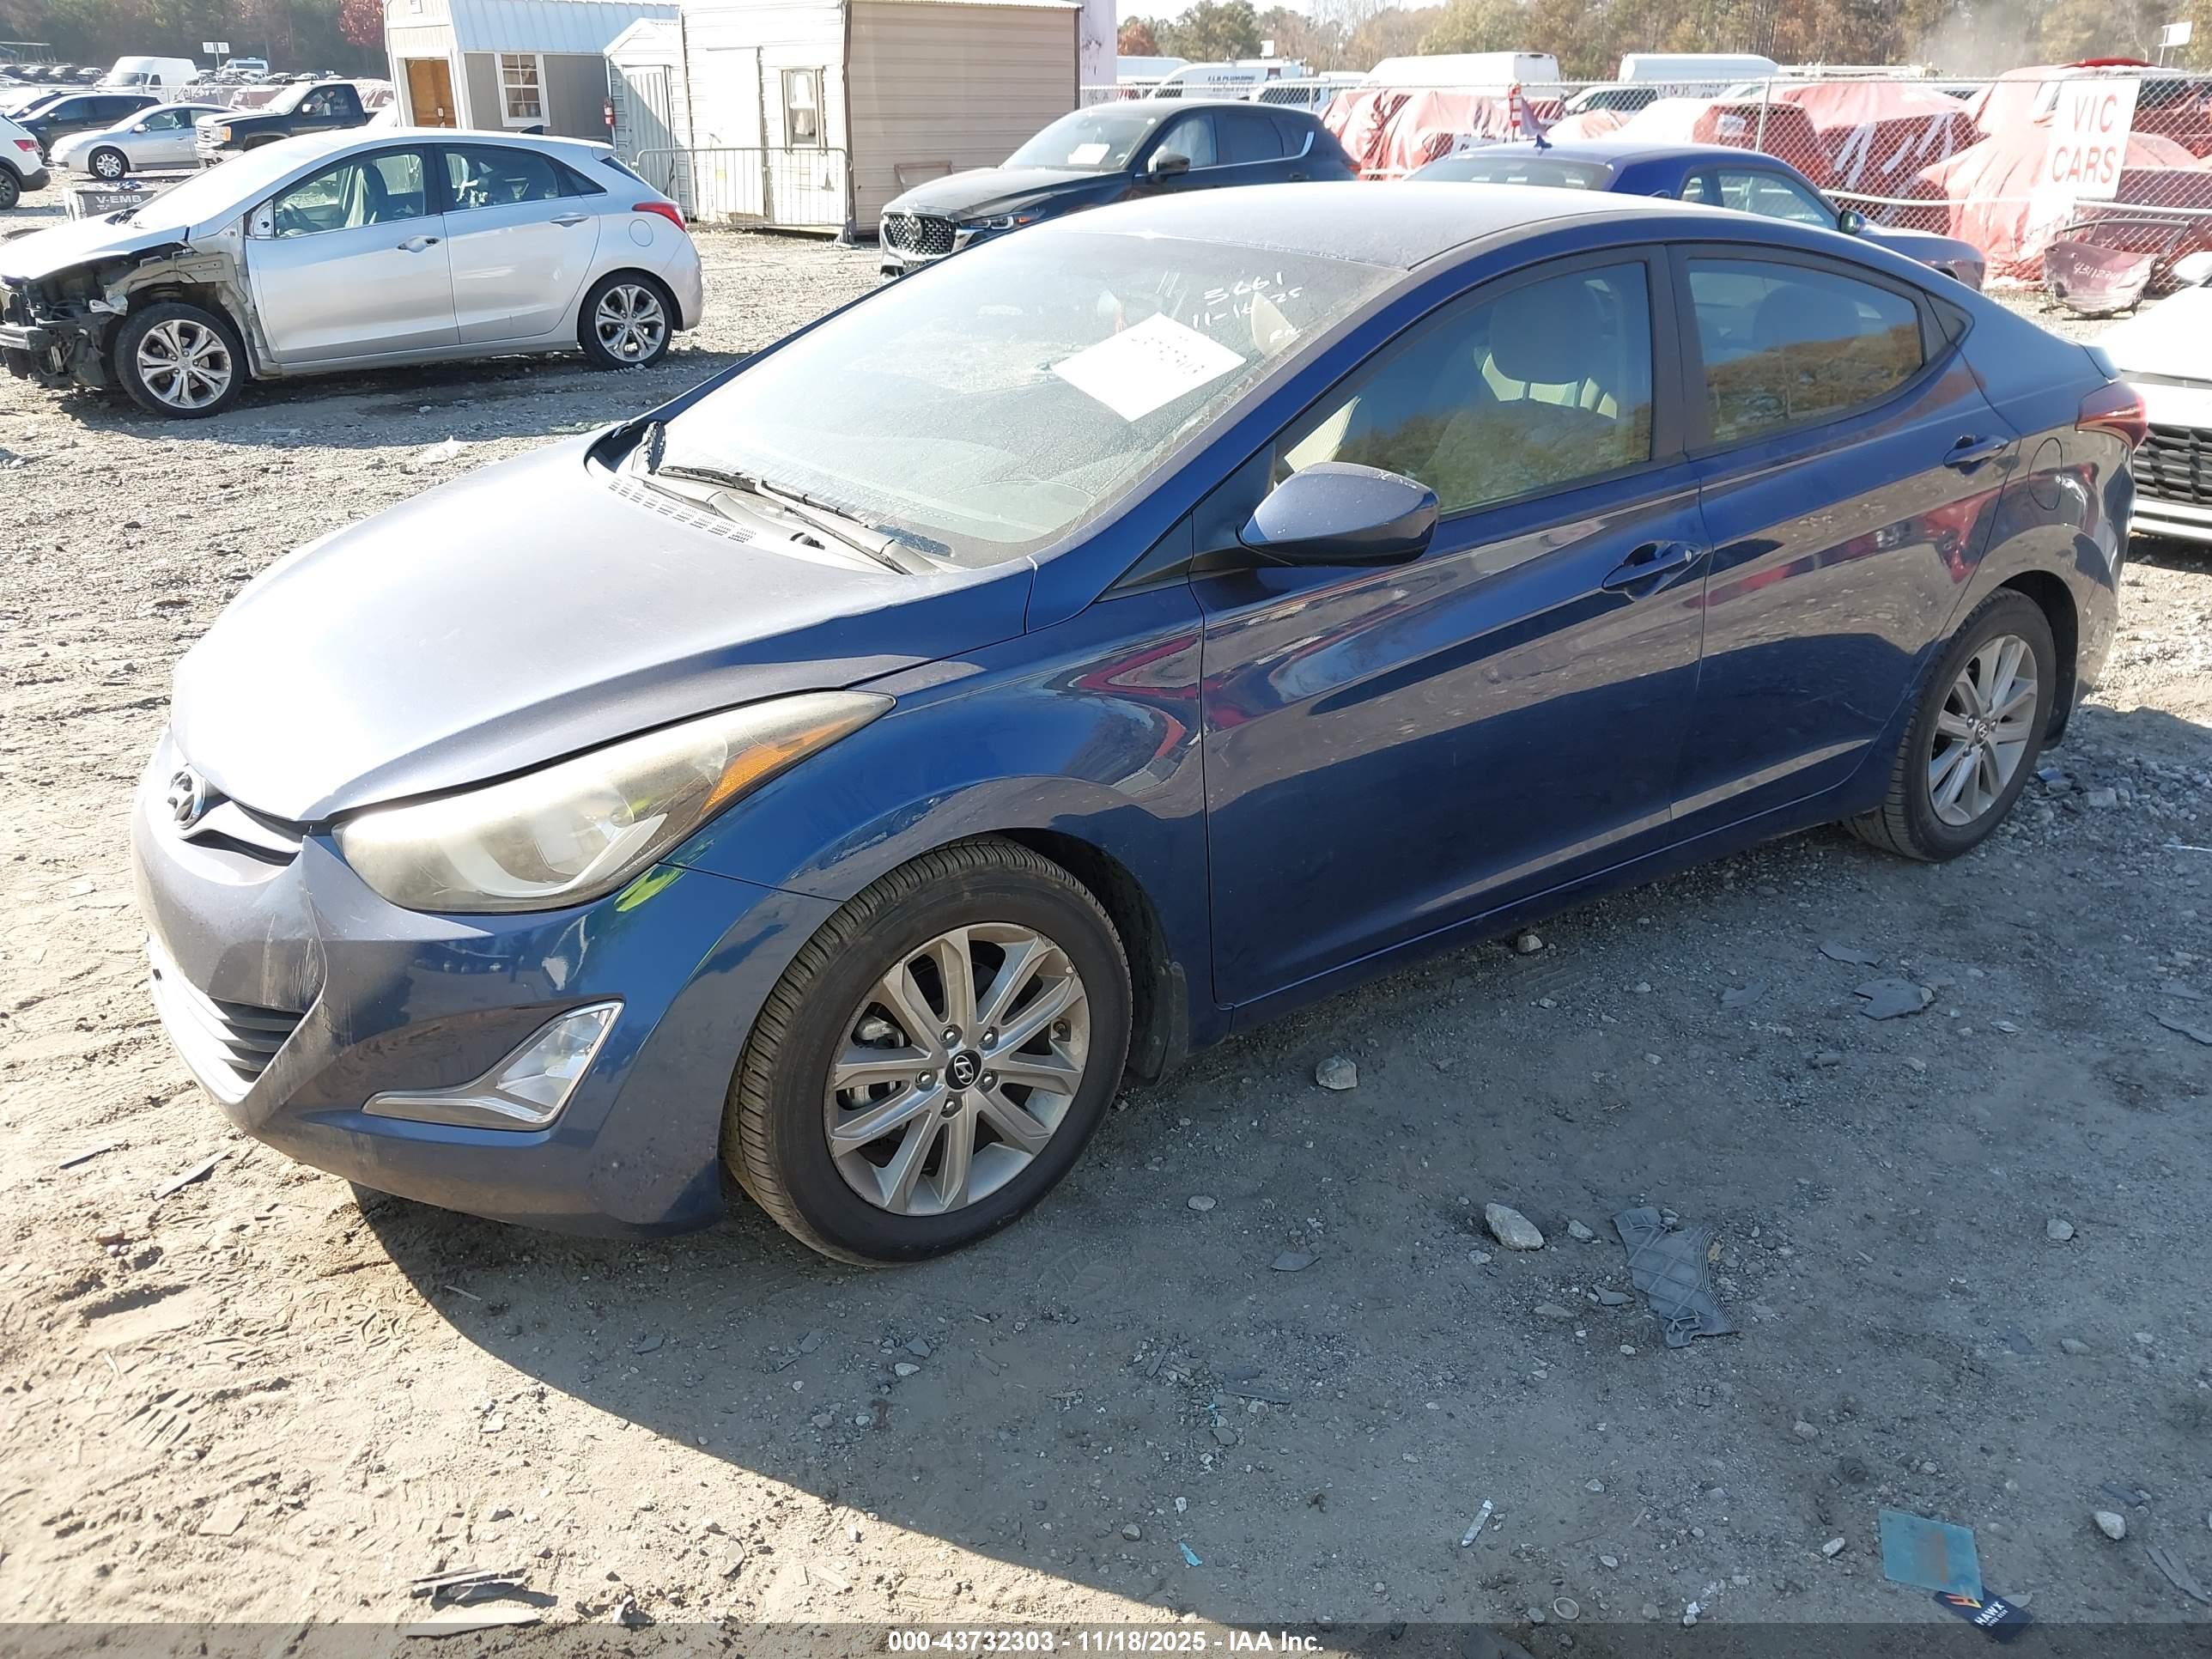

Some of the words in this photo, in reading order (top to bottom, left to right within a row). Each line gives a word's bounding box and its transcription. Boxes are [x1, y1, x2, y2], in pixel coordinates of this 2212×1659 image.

[2074, 94, 2117, 132] VIC
[2053, 146, 2117, 184] CARS
[1974, 1601, 2005, 1626] HAWX
